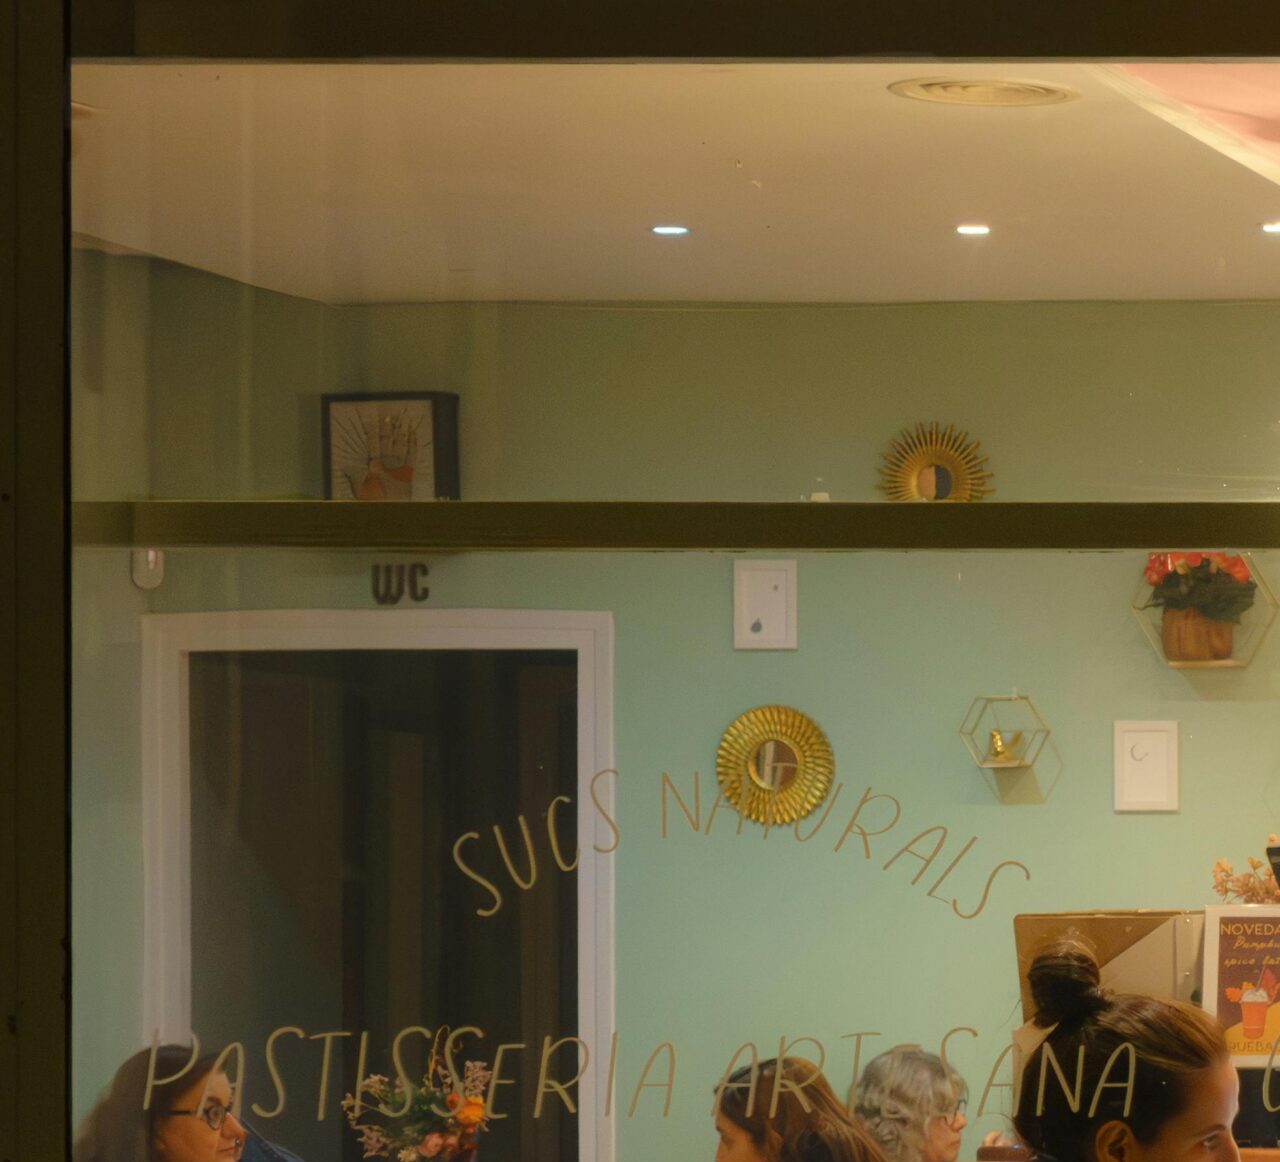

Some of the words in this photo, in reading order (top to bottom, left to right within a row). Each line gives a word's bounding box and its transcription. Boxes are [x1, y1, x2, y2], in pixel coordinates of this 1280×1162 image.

[371, 562, 430, 606] WC
[452, 768, 621, 917] SUCS
[660, 763, 1032, 920] NATURALS
[142, 1025, 677, 1121] PASTISSERIA
